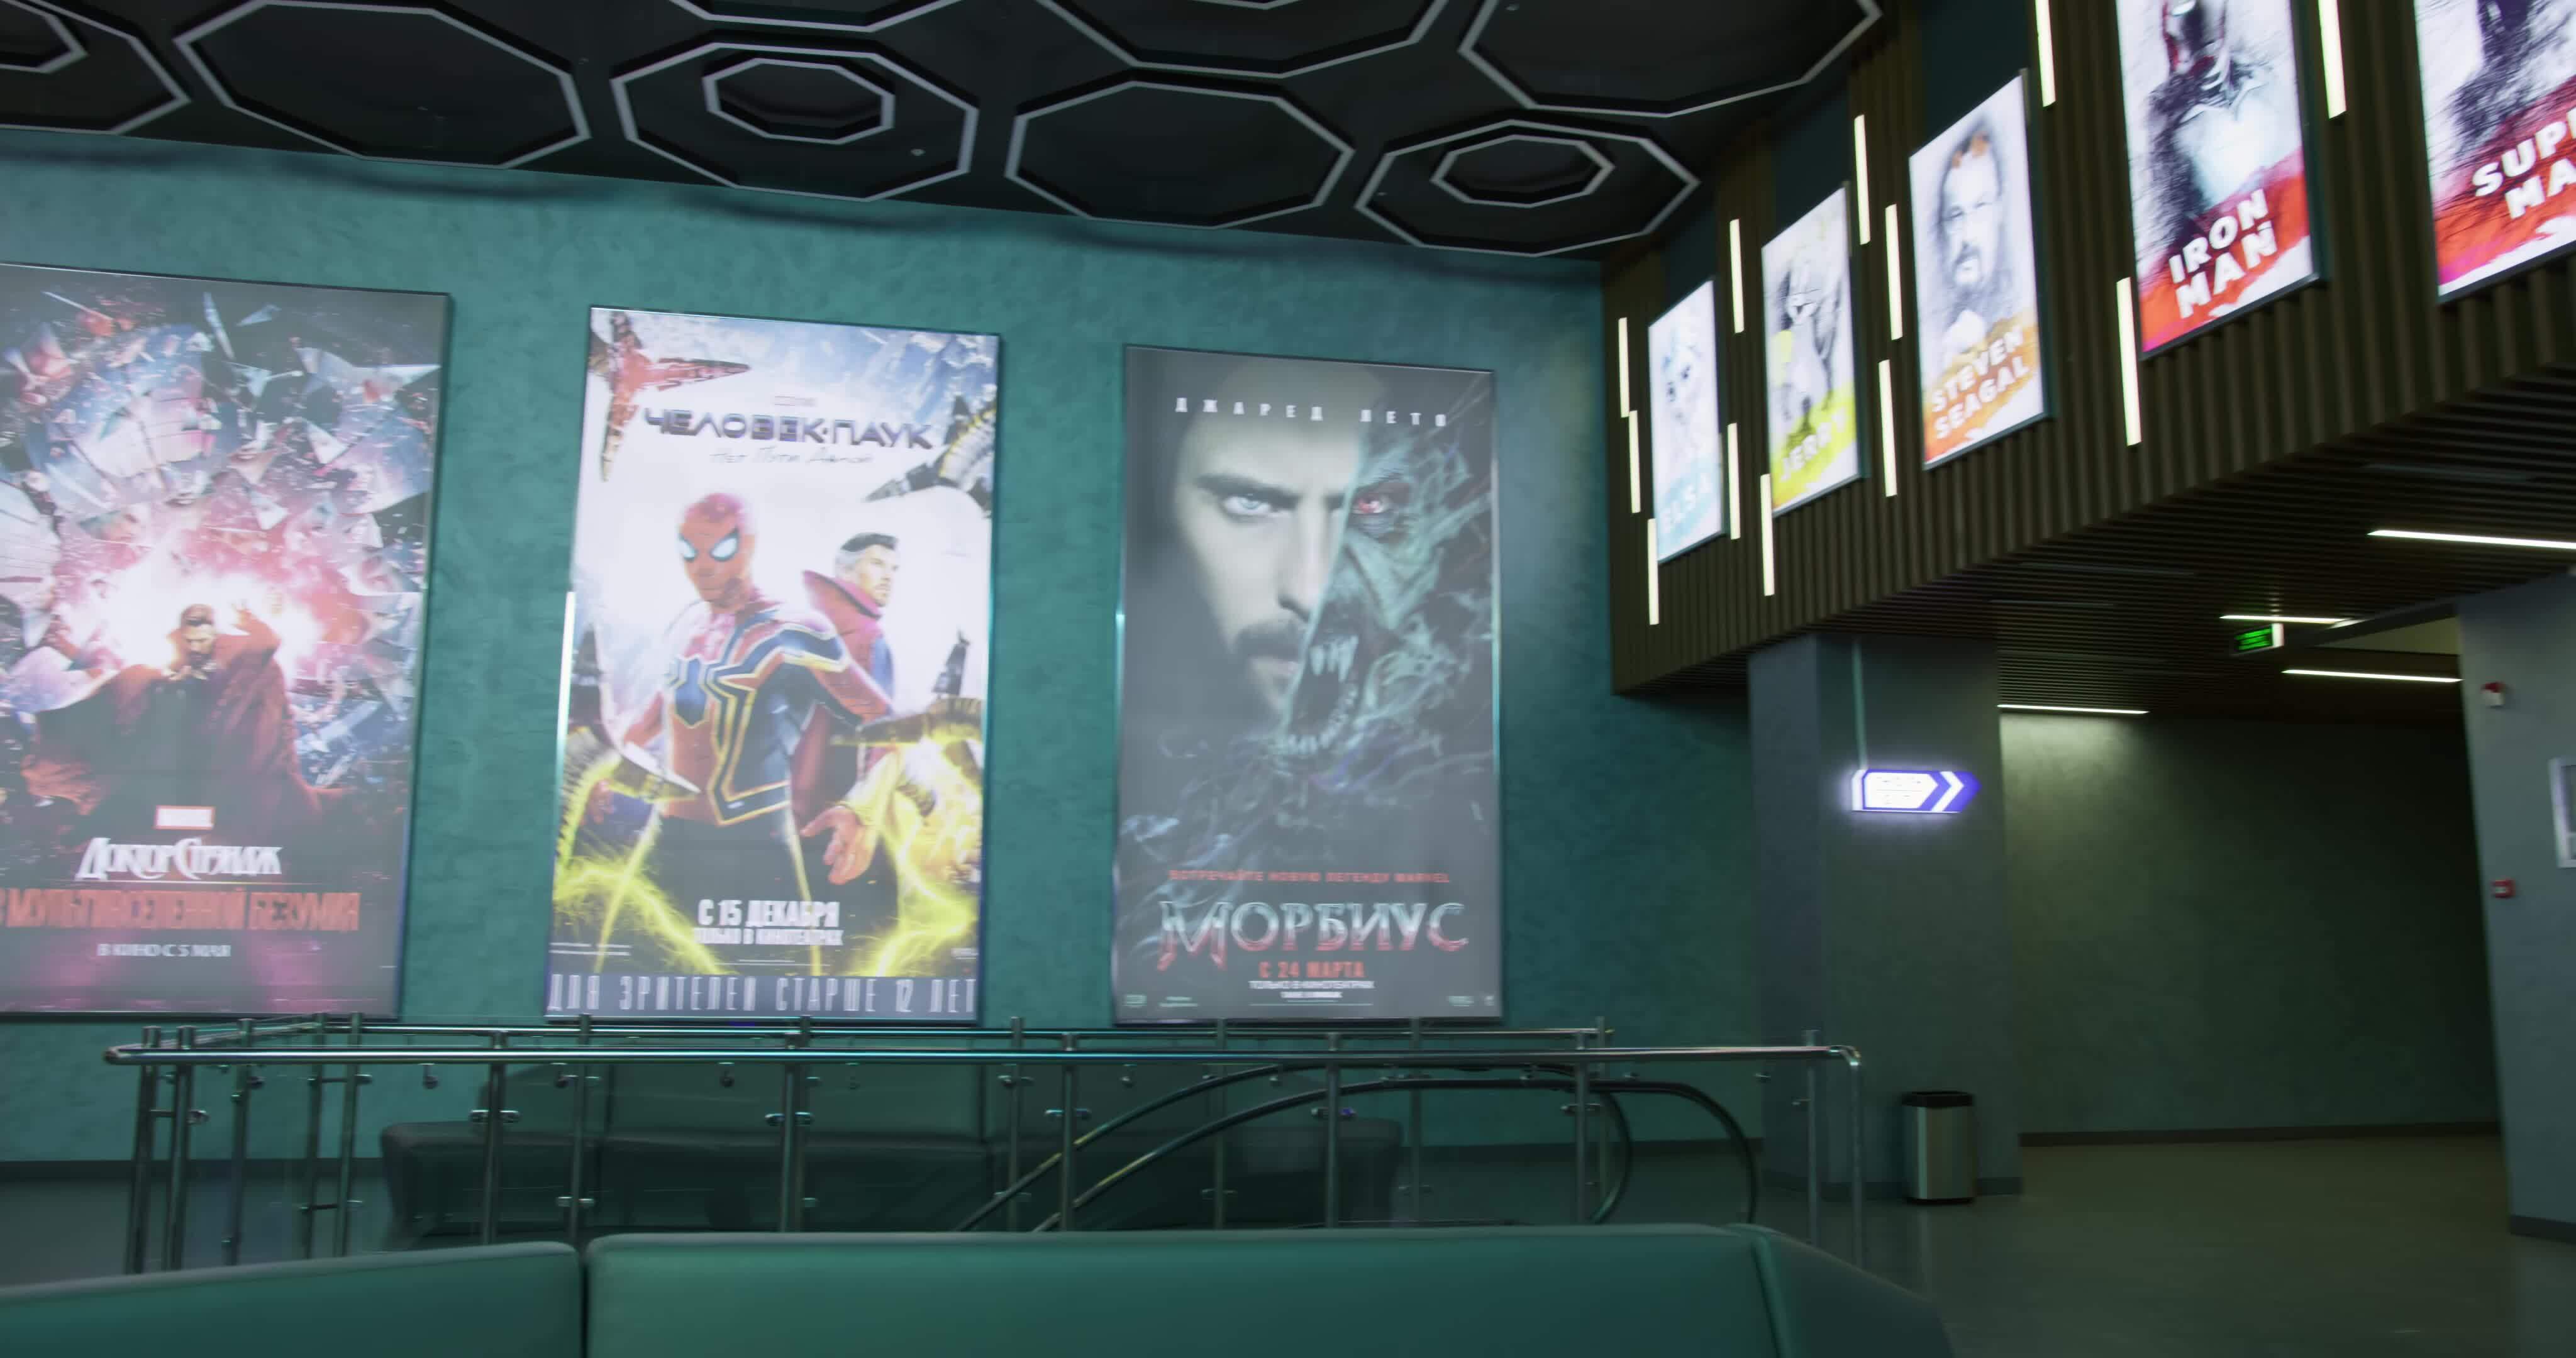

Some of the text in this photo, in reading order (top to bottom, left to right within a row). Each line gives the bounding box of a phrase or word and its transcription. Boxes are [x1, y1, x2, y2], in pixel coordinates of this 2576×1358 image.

[2168, 189, 2268, 284] IRON
[2175, 221, 2278, 319] MAN
[1932, 326, 2023, 412] STEVEN
[1934, 356, 2030, 439] SEAGAL
[697, 899, 840, 927] С 15 ДЕКАБРЯ
[1157, 901, 1468, 971] МОРБИУС
[775, 978, 877, 1012] СТАРШЕ
[1277, 961, 1300, 978] 24
